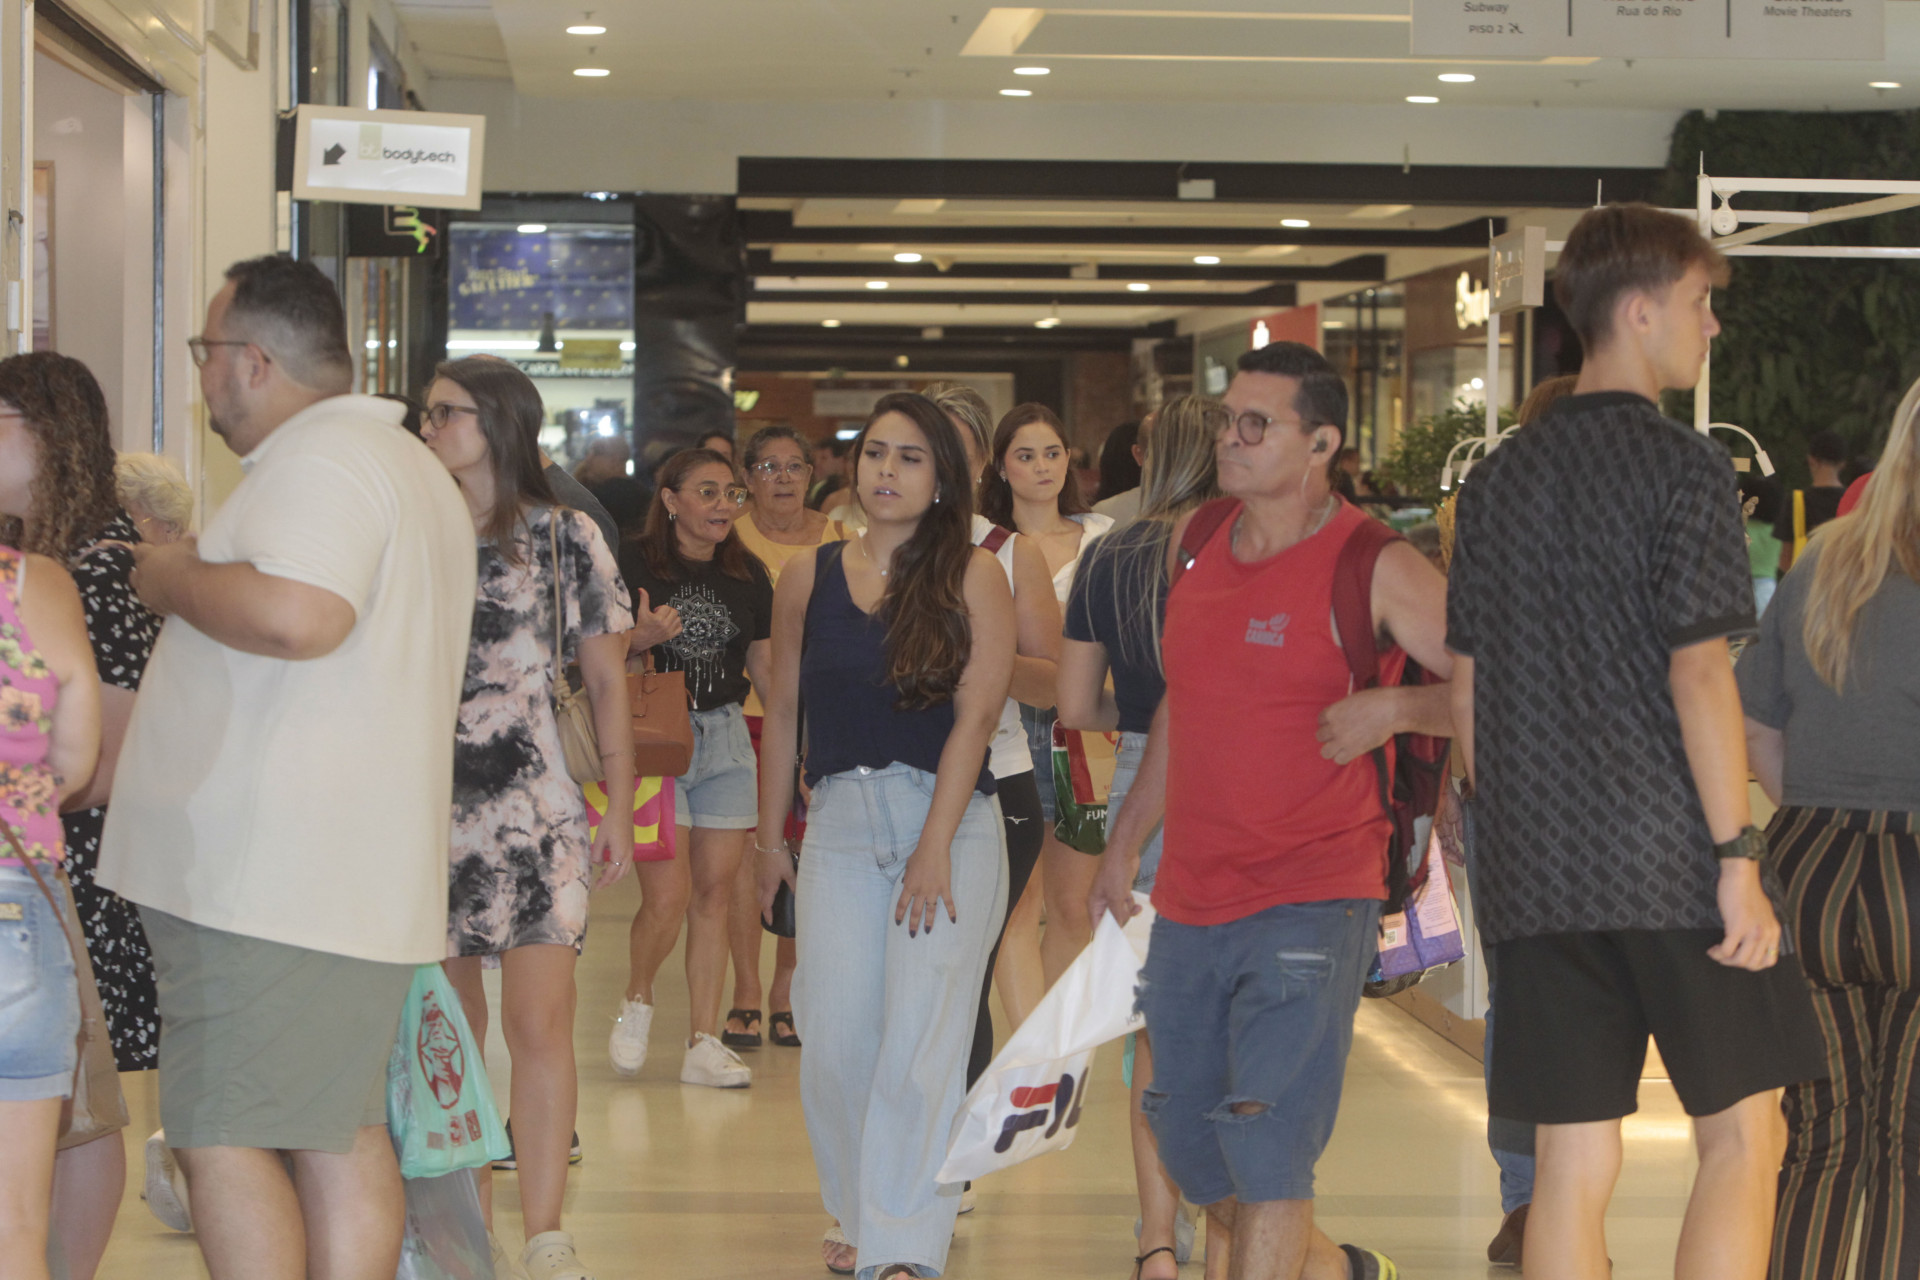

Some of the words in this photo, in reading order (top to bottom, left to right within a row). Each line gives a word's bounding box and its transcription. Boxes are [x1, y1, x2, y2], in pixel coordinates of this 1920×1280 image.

[1463, 2, 1509, 15] Subway
[1616, 5, 1640, 16] Rua
[1643, 6, 1659, 16] do
[1662, 5, 1682, 16] Rio
[1763, 6, 1798, 16] Movie
[1801, 6, 1852, 17] Theaters
[1468, 24, 1494, 34] PISO
[383, 146, 456, 164] bodytech
